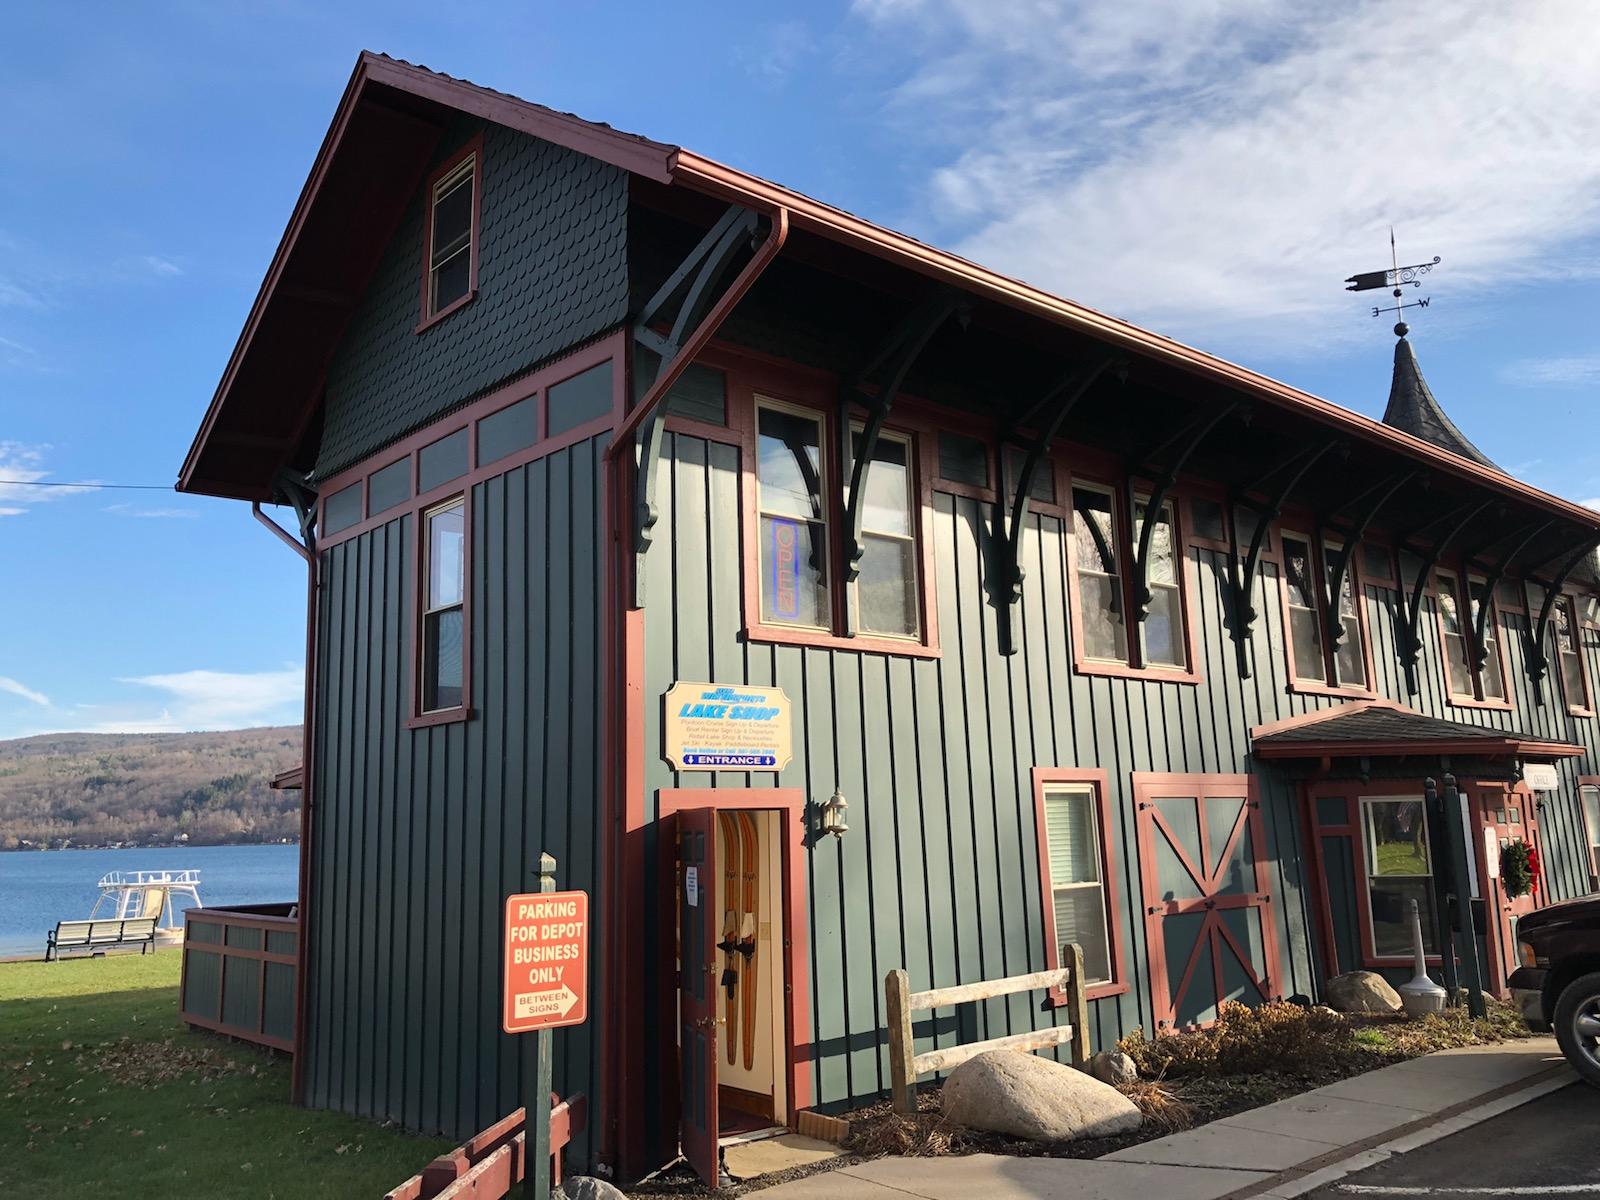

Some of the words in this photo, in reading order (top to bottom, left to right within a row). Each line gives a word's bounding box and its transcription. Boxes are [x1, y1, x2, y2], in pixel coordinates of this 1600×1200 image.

[776, 526, 794, 612] OPEN
[679, 703, 730, 719] LAKE
[729, 705, 780, 720] SHOP
[698, 756, 761, 765] ENTRANCE
[519, 901, 577, 920] PARKING
[511, 925, 537, 942] FOR
[541, 922, 583, 940] DEPOT
[514, 943, 579, 964] BUSINESS
[529, 966, 564, 984] ONLY
[519, 992, 568, 1005] BETWEEN
[529, 1003, 559, 1014] SIGNS
